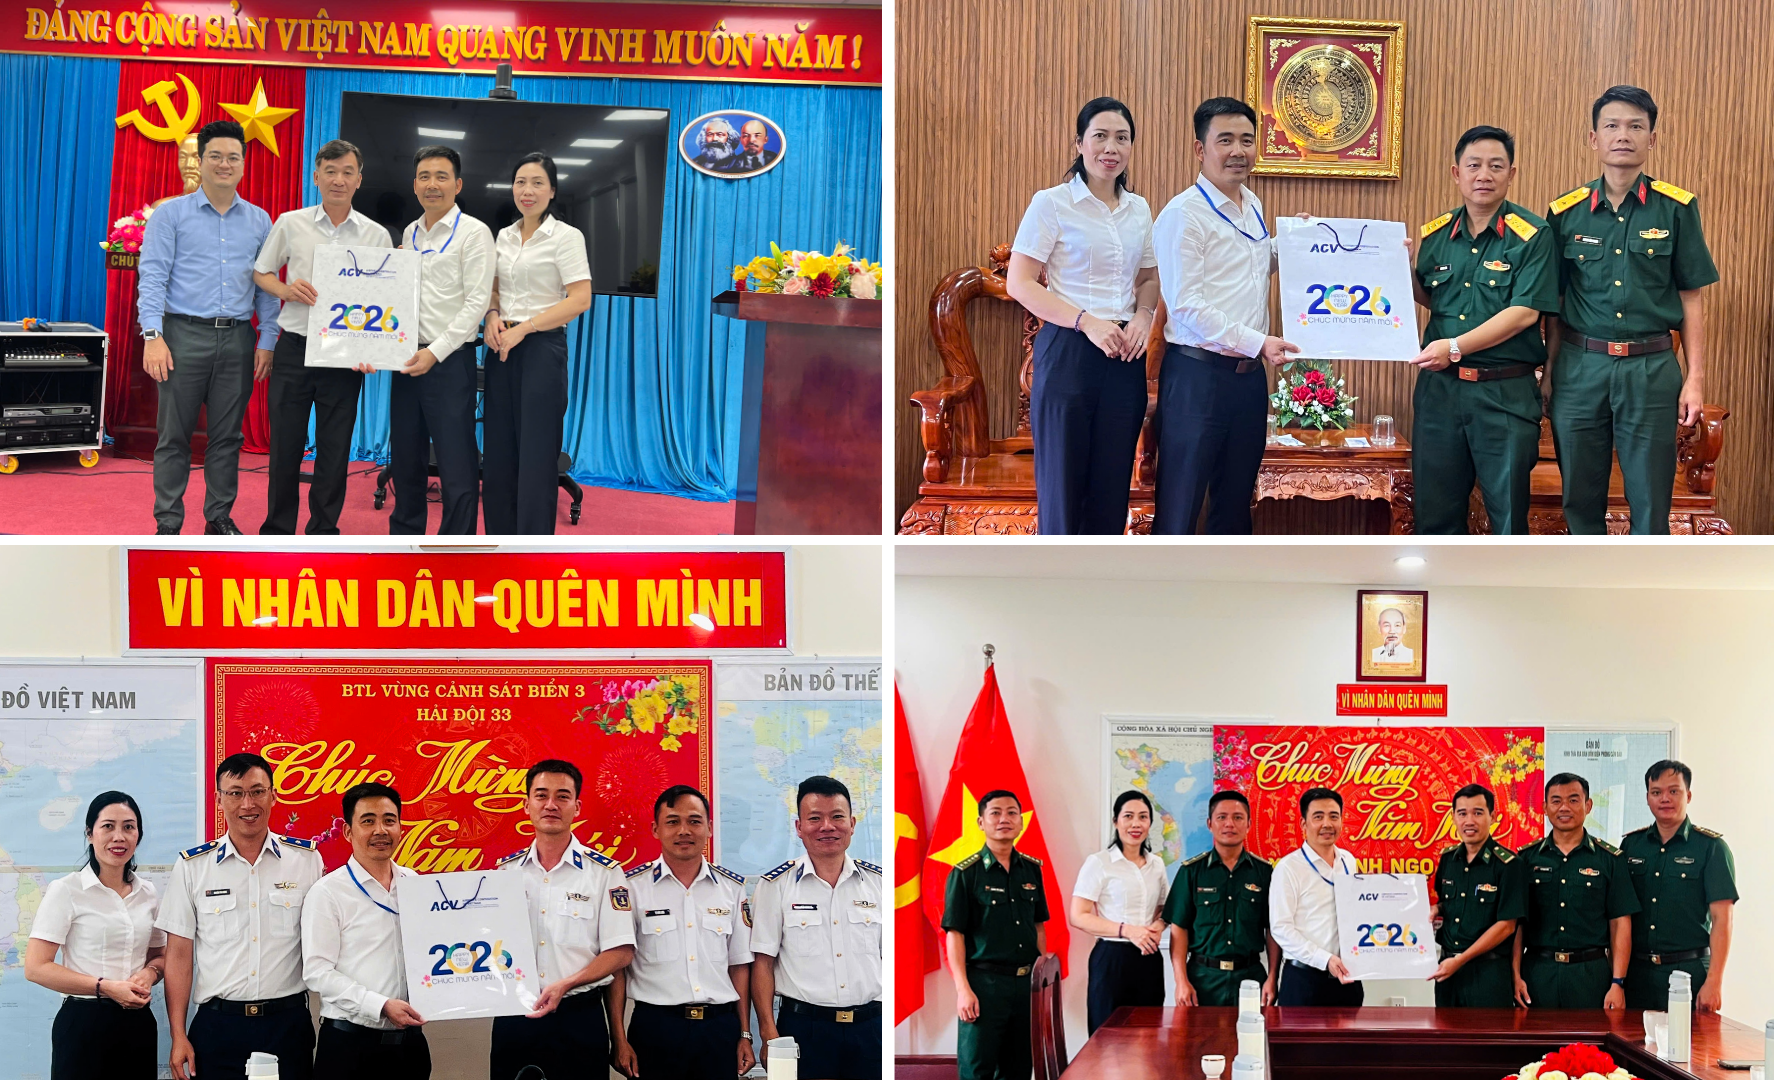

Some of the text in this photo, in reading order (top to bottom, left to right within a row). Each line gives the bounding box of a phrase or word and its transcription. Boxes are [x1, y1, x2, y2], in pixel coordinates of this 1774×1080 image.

[25, 0, 111, 43] ĐẢNG
[115, 1, 198, 53] CỘNG
[205, 0, 271, 50] SẢN
[275, 8, 353, 60] VIỆT
[359, 21, 431, 57] NAM
[436, 23, 547, 65] QUANG
[555, 28, 647, 63] VINH
[652, 19, 755, 67] MUÔN
[1310, 243, 1339, 253] ACV
[1306, 284, 1391, 317] 2026
[329, 303, 399, 332] 2026
[158, 567, 761, 634] VÌ NHÂN DÂN QUÊN MÌNH
[342, 677, 585, 697] BTL VÙNG CẢNH SÁT BIỂN 3
[764, 667, 881, 691] BẢN ĐỒ THẾ
[1, 683, 136, 712] ĐỒ VIỆT NAM
[1342, 689, 1443, 711] VÌ NHÂN DÂN QUÊN MÌNH
[416, 704, 511, 725] HẢI ĐỘI 33
[1250, 741, 1420, 801] Chúc Mừng
[1349, 800, 1423, 841] Năm
[430, 900, 459, 911] ACV
[1358, 893, 1379, 901] ACV
[1357, 923, 1417, 947] 2026
[429, 940, 512, 976] 2026
